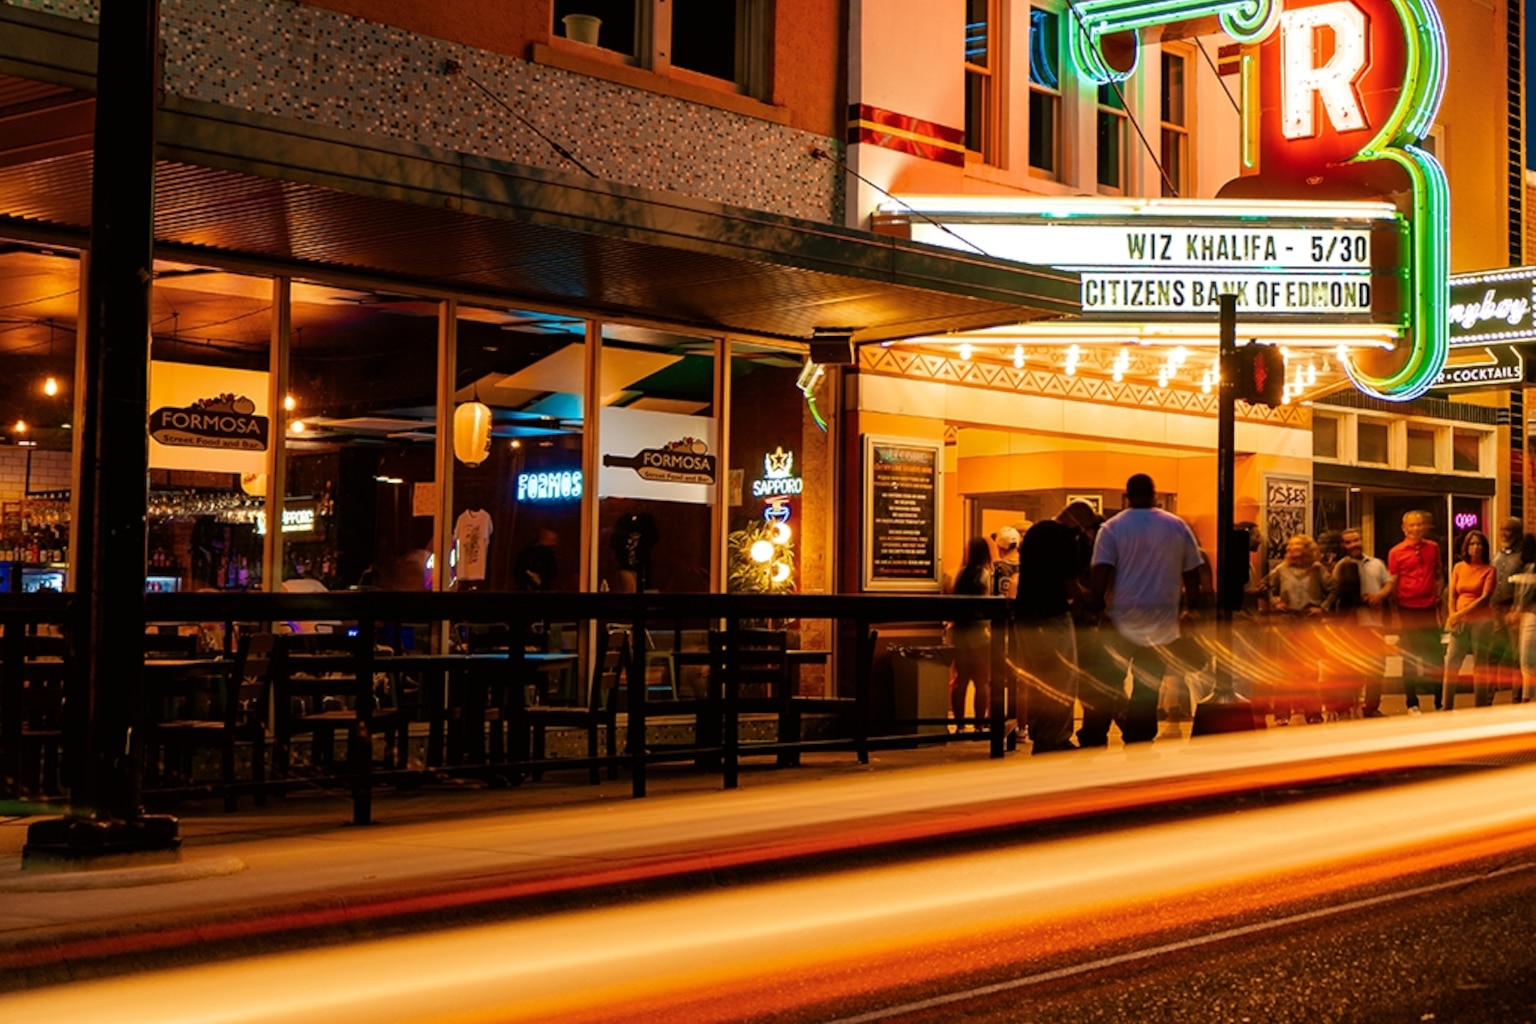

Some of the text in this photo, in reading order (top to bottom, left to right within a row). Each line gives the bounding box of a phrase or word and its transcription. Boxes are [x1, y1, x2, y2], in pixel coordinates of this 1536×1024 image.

[1127, 233, 1172, 260] WIZ
[1186, 234, 1277, 261] KHALIFA
[1310, 235, 1367, 262] 5/30
[1085, 279, 1185, 306] CITIZENS
[1257, 281, 1280, 307] OF
[1285, 281, 1370, 307] EDMOND
[1453, 366, 1520, 382] COCKTAILS
[161, 411, 260, 434] FORMOSA
[163, 434, 193, 443] Street
[196, 437, 220, 446] Food
[222, 439, 239, 447] and
[643, 452, 711, 471] FORMOSA
[753, 478, 803, 496] SAPPORO
